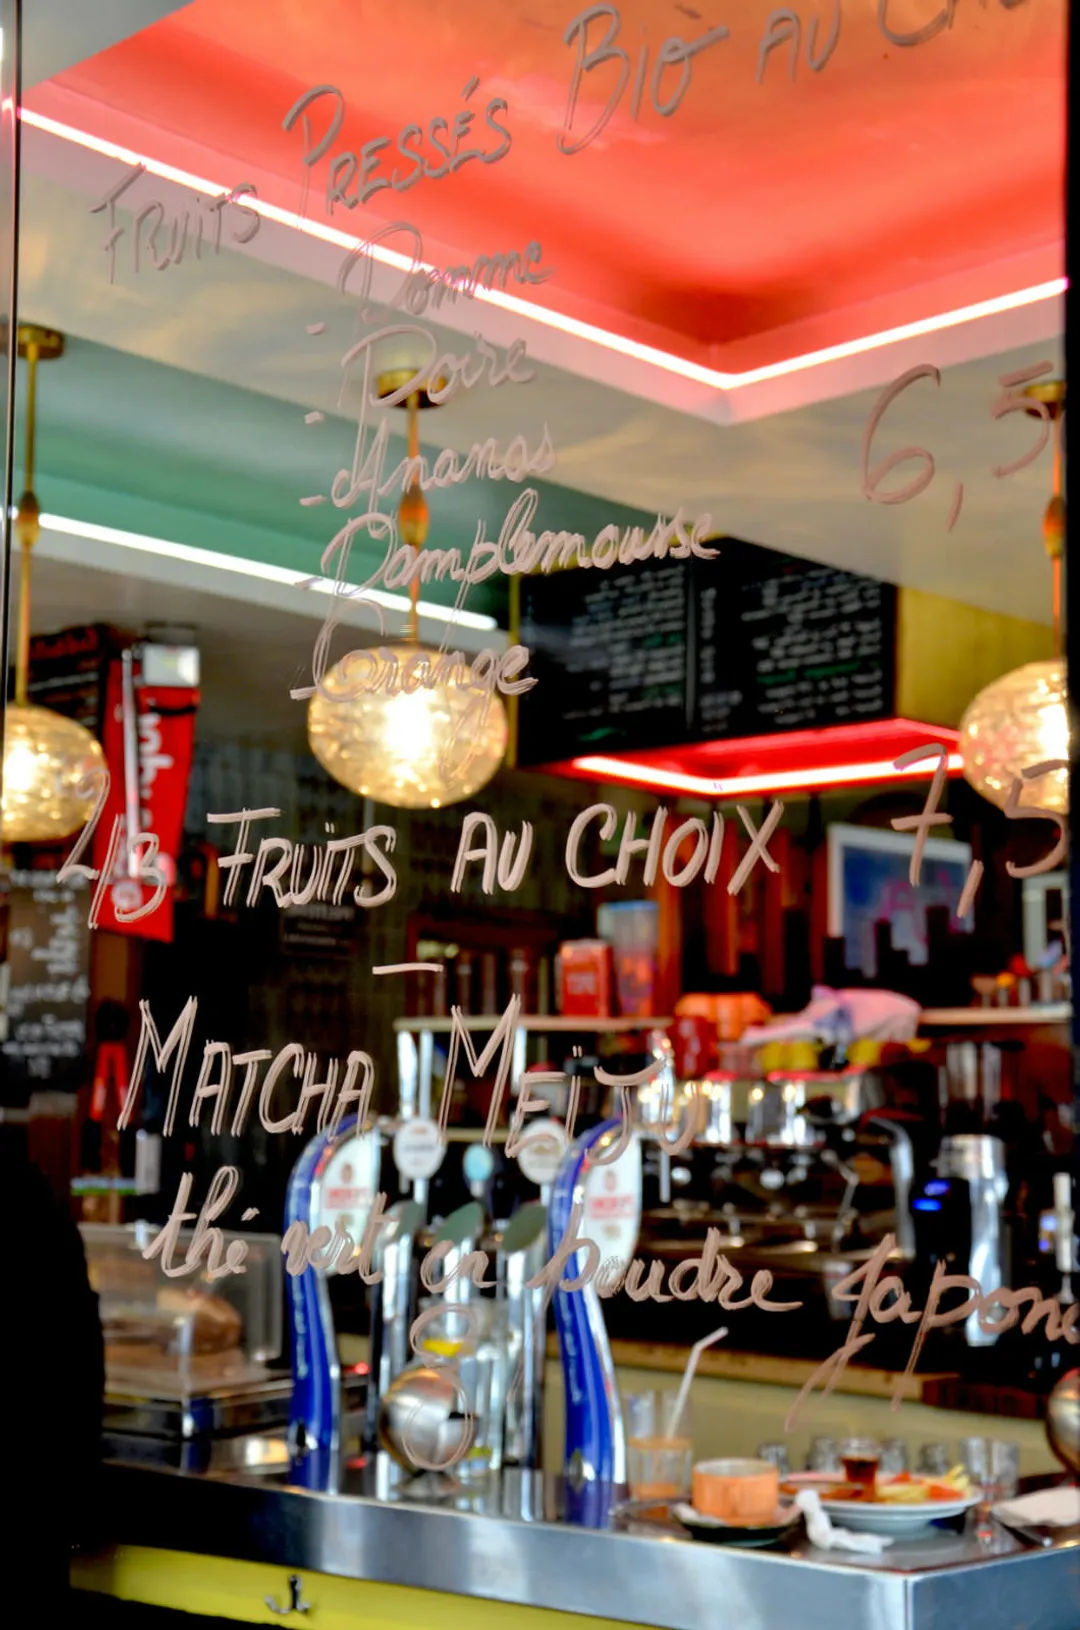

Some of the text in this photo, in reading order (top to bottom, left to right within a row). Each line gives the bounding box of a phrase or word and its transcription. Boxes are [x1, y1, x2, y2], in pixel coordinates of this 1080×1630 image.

[283, 76, 512, 226] PRESSÉS
[756, 0, 840, 84] AU
[338, 221, 556, 326] Pomme
[337, 324, 538, 475] Poire
[331, 418, 556, 538] Ananas
[312, 598, 538, 780] Orange
[450, 811, 533, 895] AU
[565, 800, 785, 895] CHOIX
[116, 995, 375, 1142] MATCHA
[142, 1166, 260, 1278] thé
[281, 1191, 400, 1286] vert
[420, 1240, 499, 1293] en
